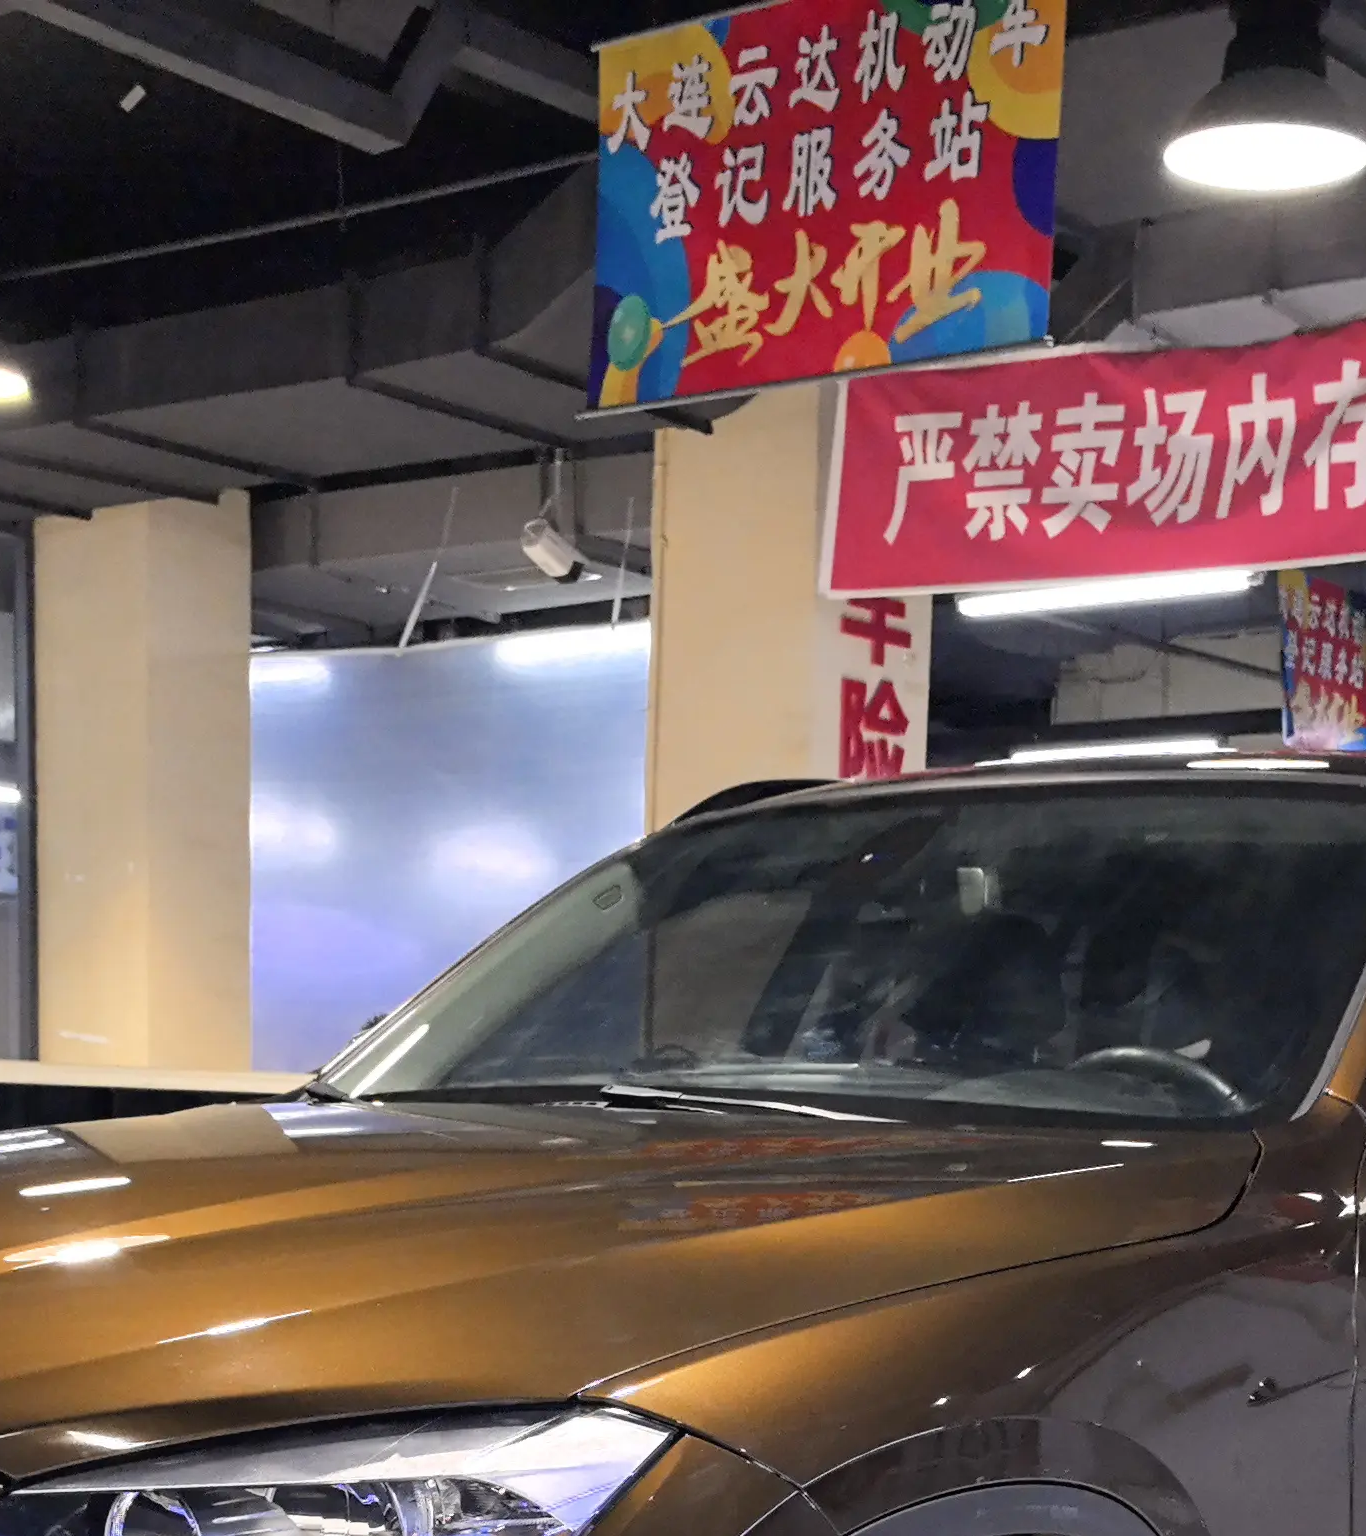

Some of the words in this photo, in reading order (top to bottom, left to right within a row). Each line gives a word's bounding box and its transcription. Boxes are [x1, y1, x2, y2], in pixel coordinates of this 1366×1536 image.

[605, 0, 1048, 154] 大连云达机动车
[650, 92, 989, 244] 登记服务站
[659, 198, 987, 368] 盛大开业
